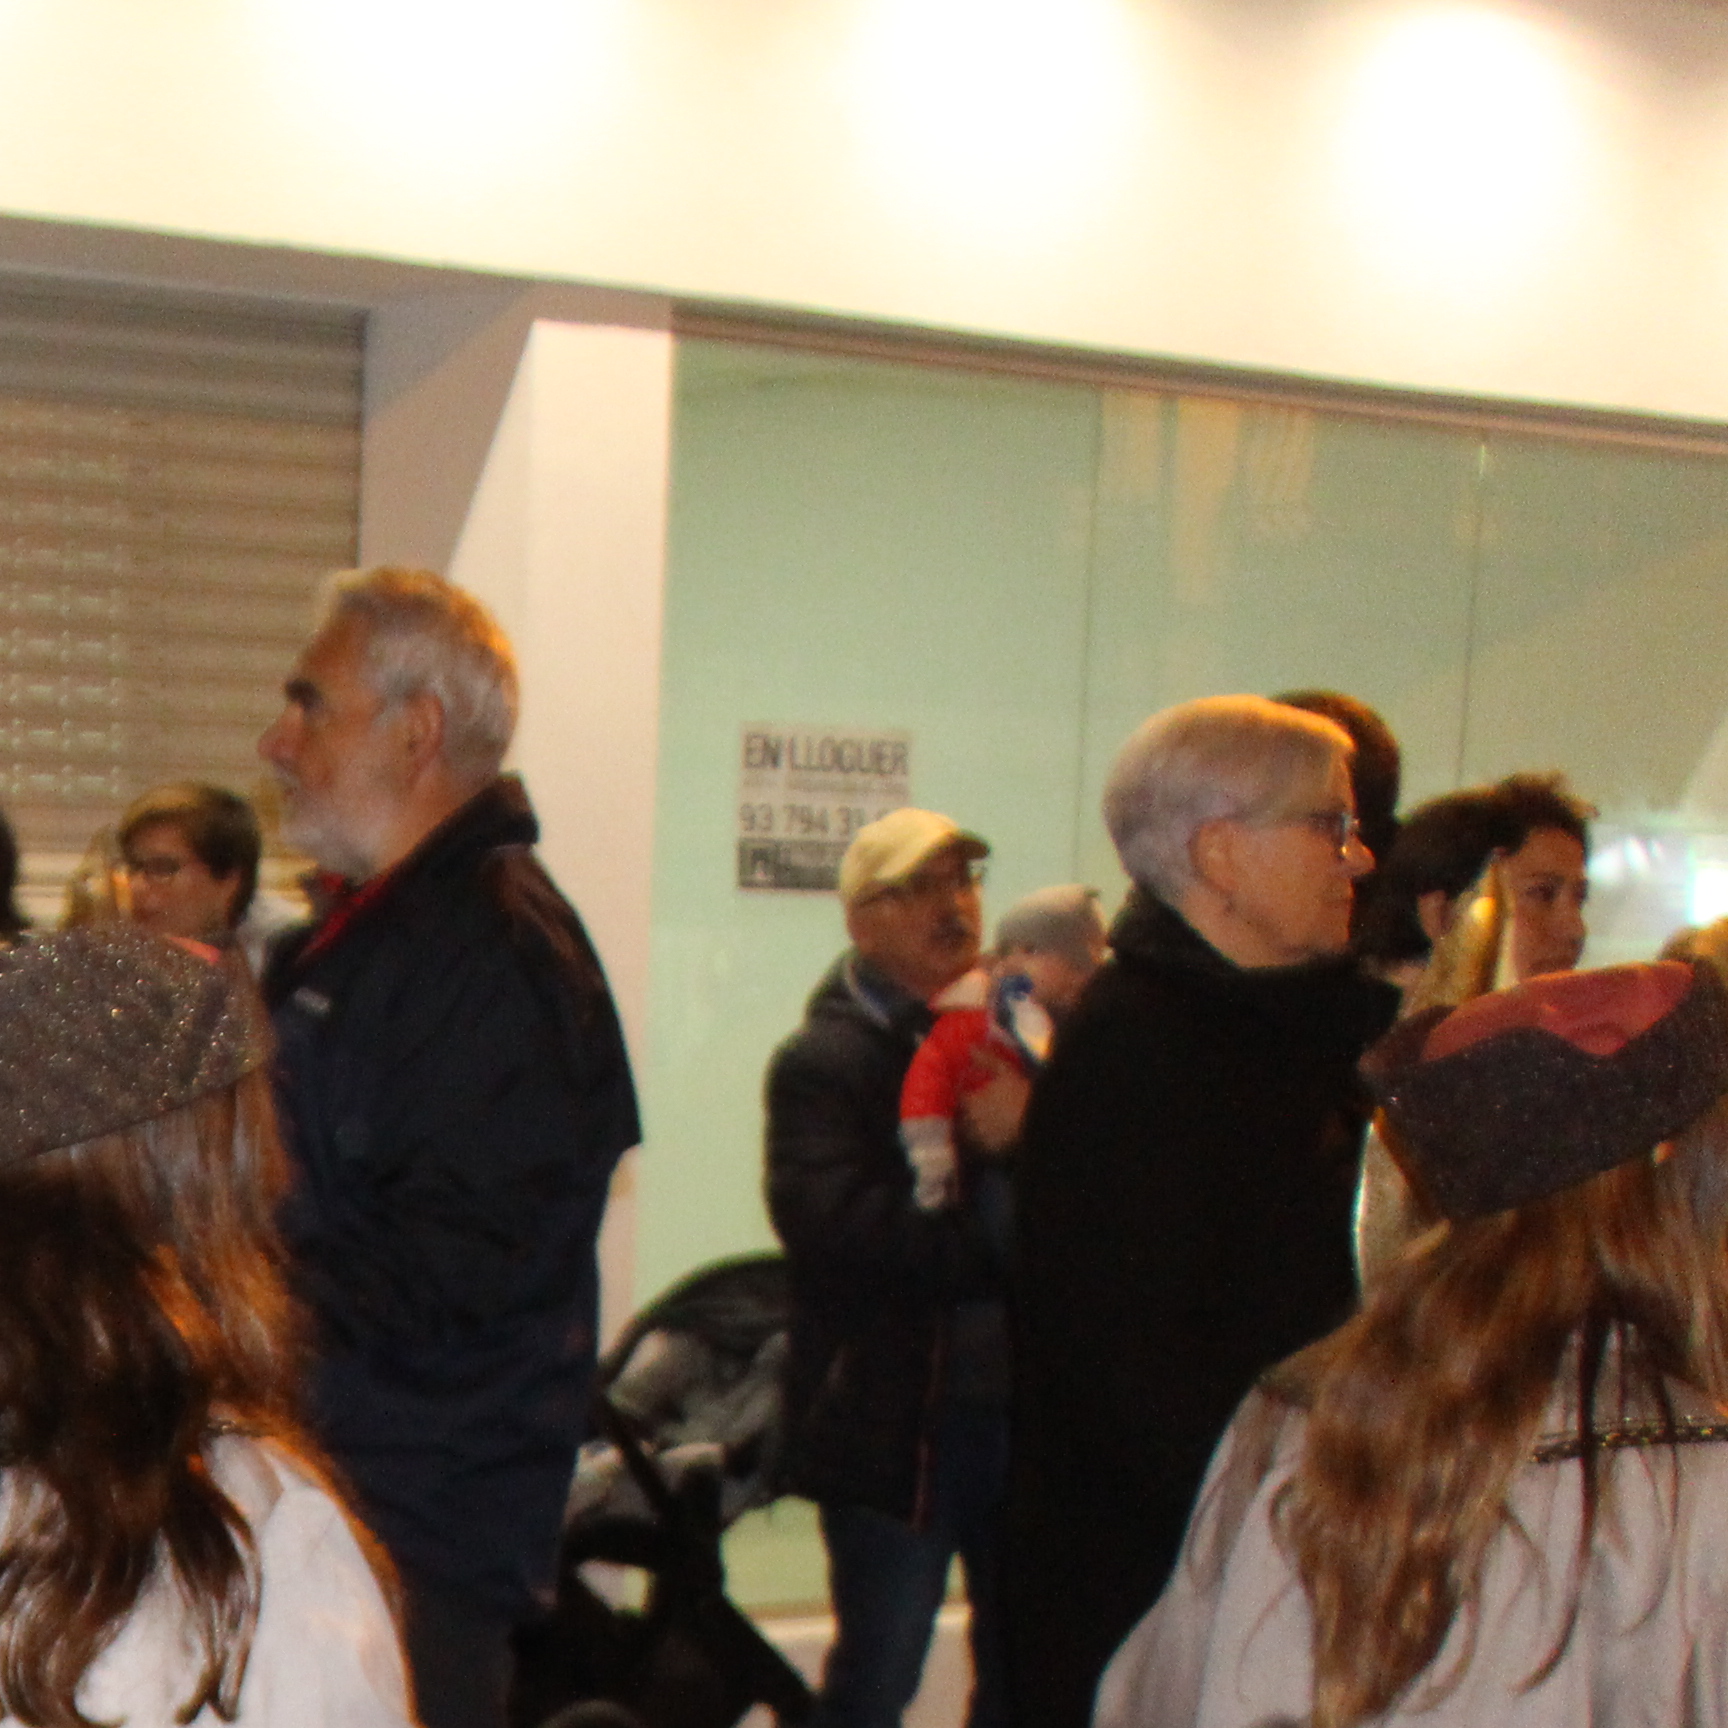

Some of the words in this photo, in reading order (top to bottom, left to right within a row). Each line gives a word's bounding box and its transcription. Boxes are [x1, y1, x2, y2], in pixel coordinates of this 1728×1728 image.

[744, 732, 783, 769] EN
[787, 735, 909, 776] LLOGUER
[740, 802, 774, 833] 93
